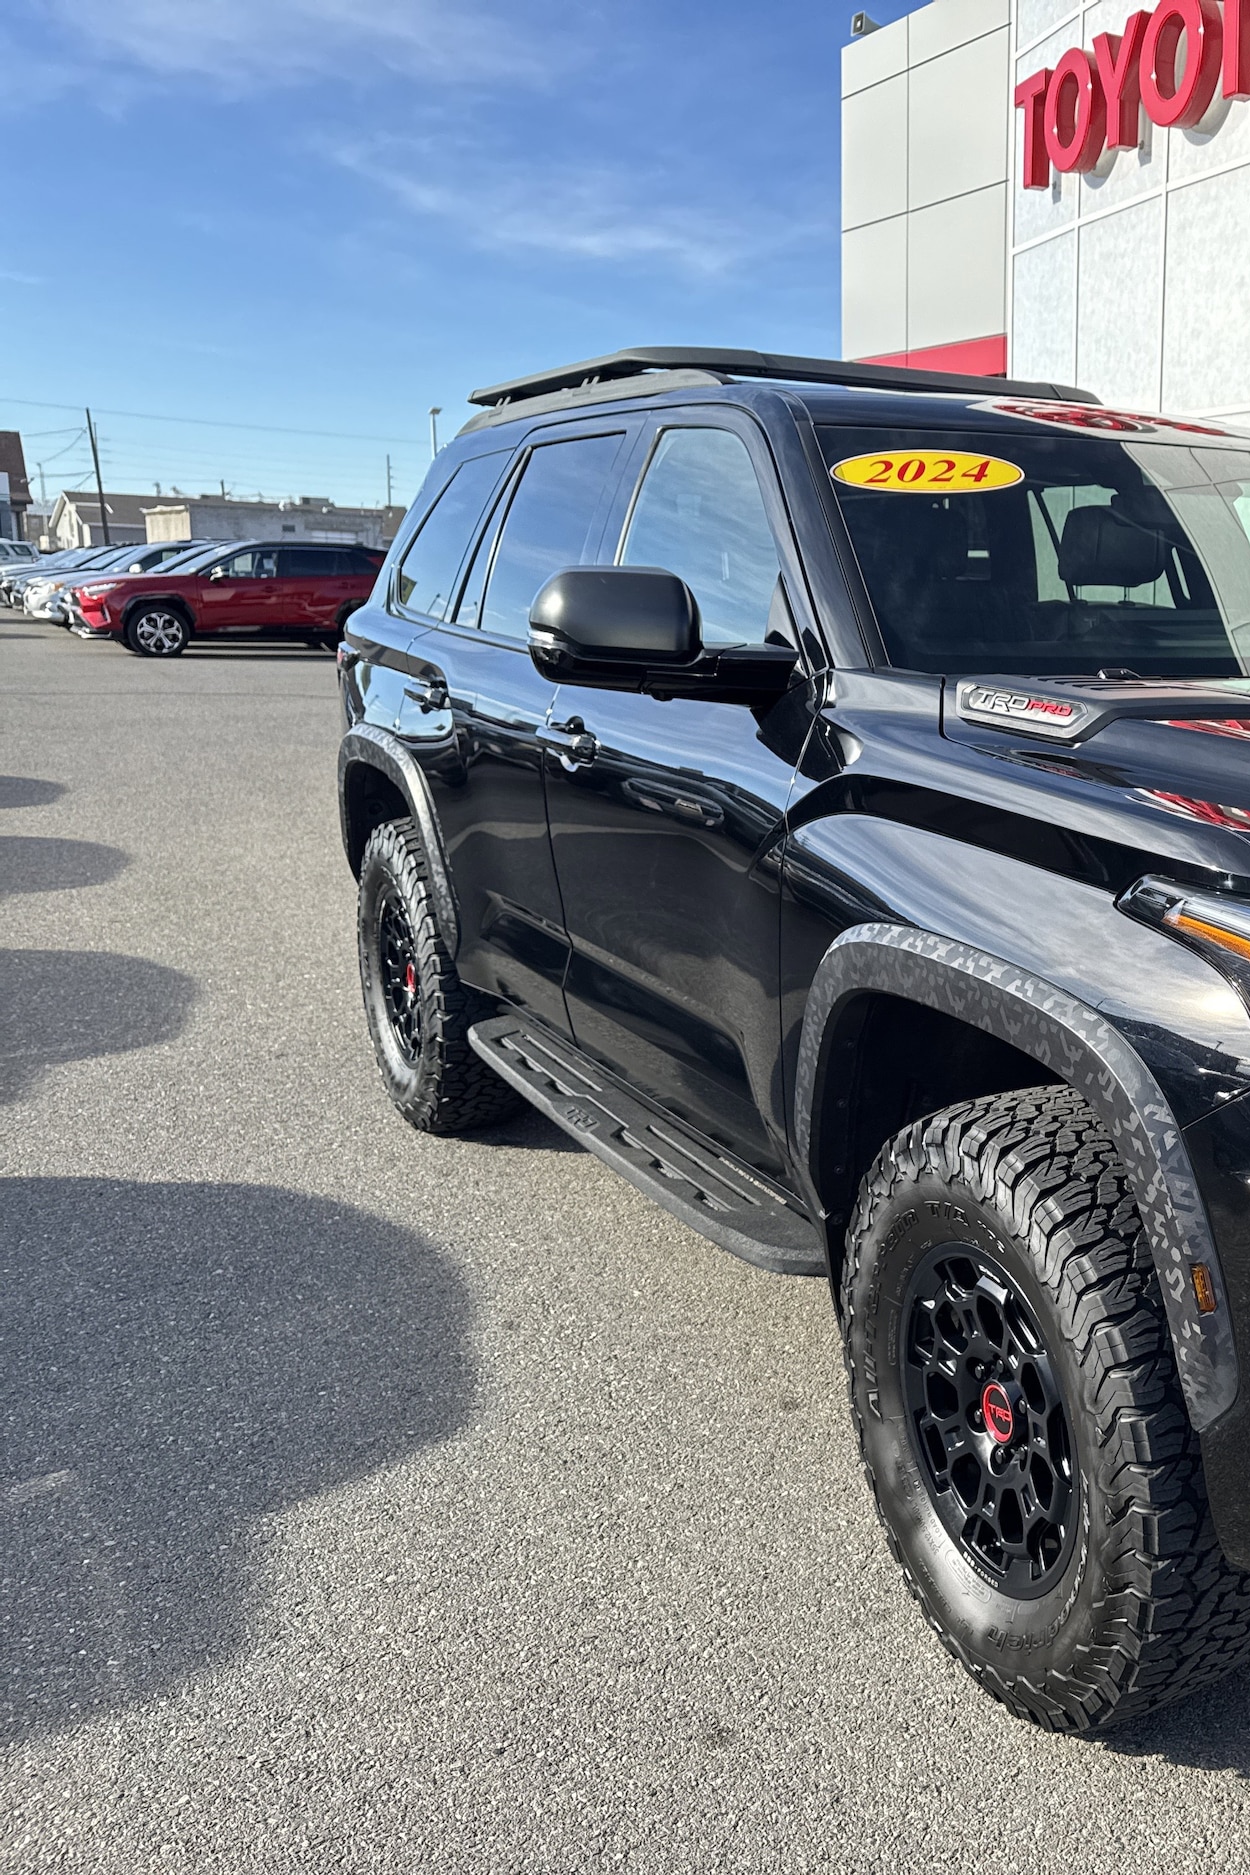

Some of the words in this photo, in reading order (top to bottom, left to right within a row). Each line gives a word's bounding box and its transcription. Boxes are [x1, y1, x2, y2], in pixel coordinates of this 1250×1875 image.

[864, 459, 990, 484] 2024
[977, 690, 1029, 713] TRD
[1027, 699, 1073, 717] PRO
[988, 1403, 1012, 1422] TRD
